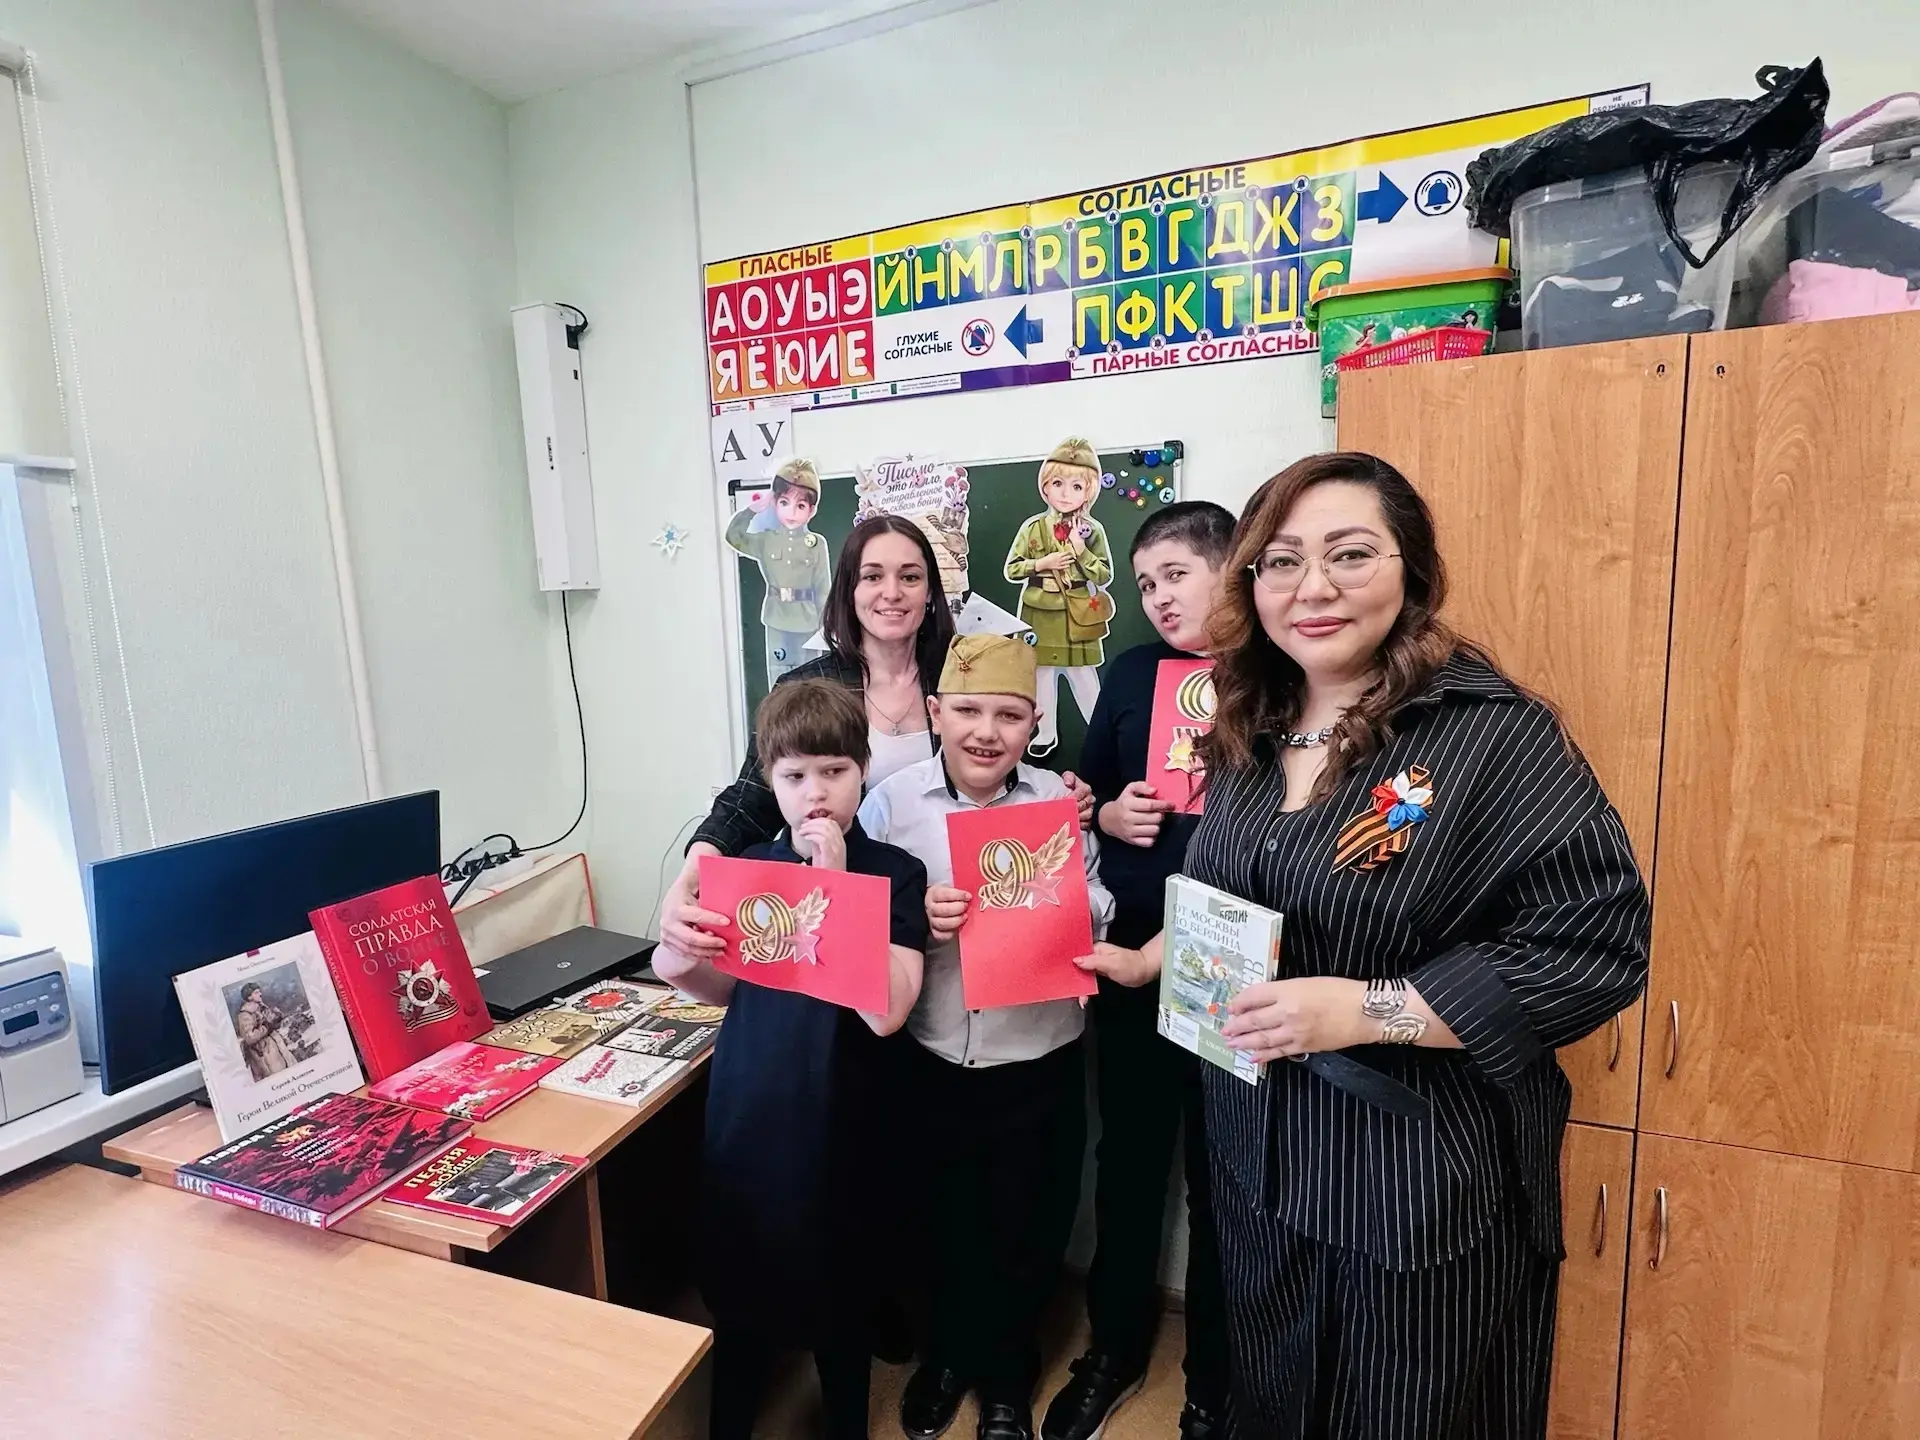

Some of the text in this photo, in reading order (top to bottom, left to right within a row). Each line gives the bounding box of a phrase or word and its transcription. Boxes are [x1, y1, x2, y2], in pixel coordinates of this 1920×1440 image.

[1078, 167, 1246, 216] СОГЛАСНЫЕ
[740, 245, 833, 278] ГЛАСНЫЕ
[884, 341, 953, 360] СОГЛАСНЫЕ
[896, 331, 939, 346] ГЛУХИЕ
[1092, 333, 1320, 374] ПАРНЫЕ СОГЛАСНЫ
[720, 421, 786, 462] А У
[877, 461, 935, 486] Письмо
[881, 486, 943, 505] отправленное
[349, 898, 437, 937] СОЛДАТСКАЯ
[1173, 903, 1240, 938] ОТ МОСКВЫ
[354, 914, 444, 958] ПРАВДА
[1190, 921, 1241, 951] БЕРЛИНА
[363, 959, 379, 975] О
[237, 1061, 354, 1123] Герои Великой Отечественной
[199, 1098, 333, 1165] Парад Победы
[404, 1147, 468, 1188] ПЕСНЯ
[428, 1154, 479, 1188] ВОЙНЕ
